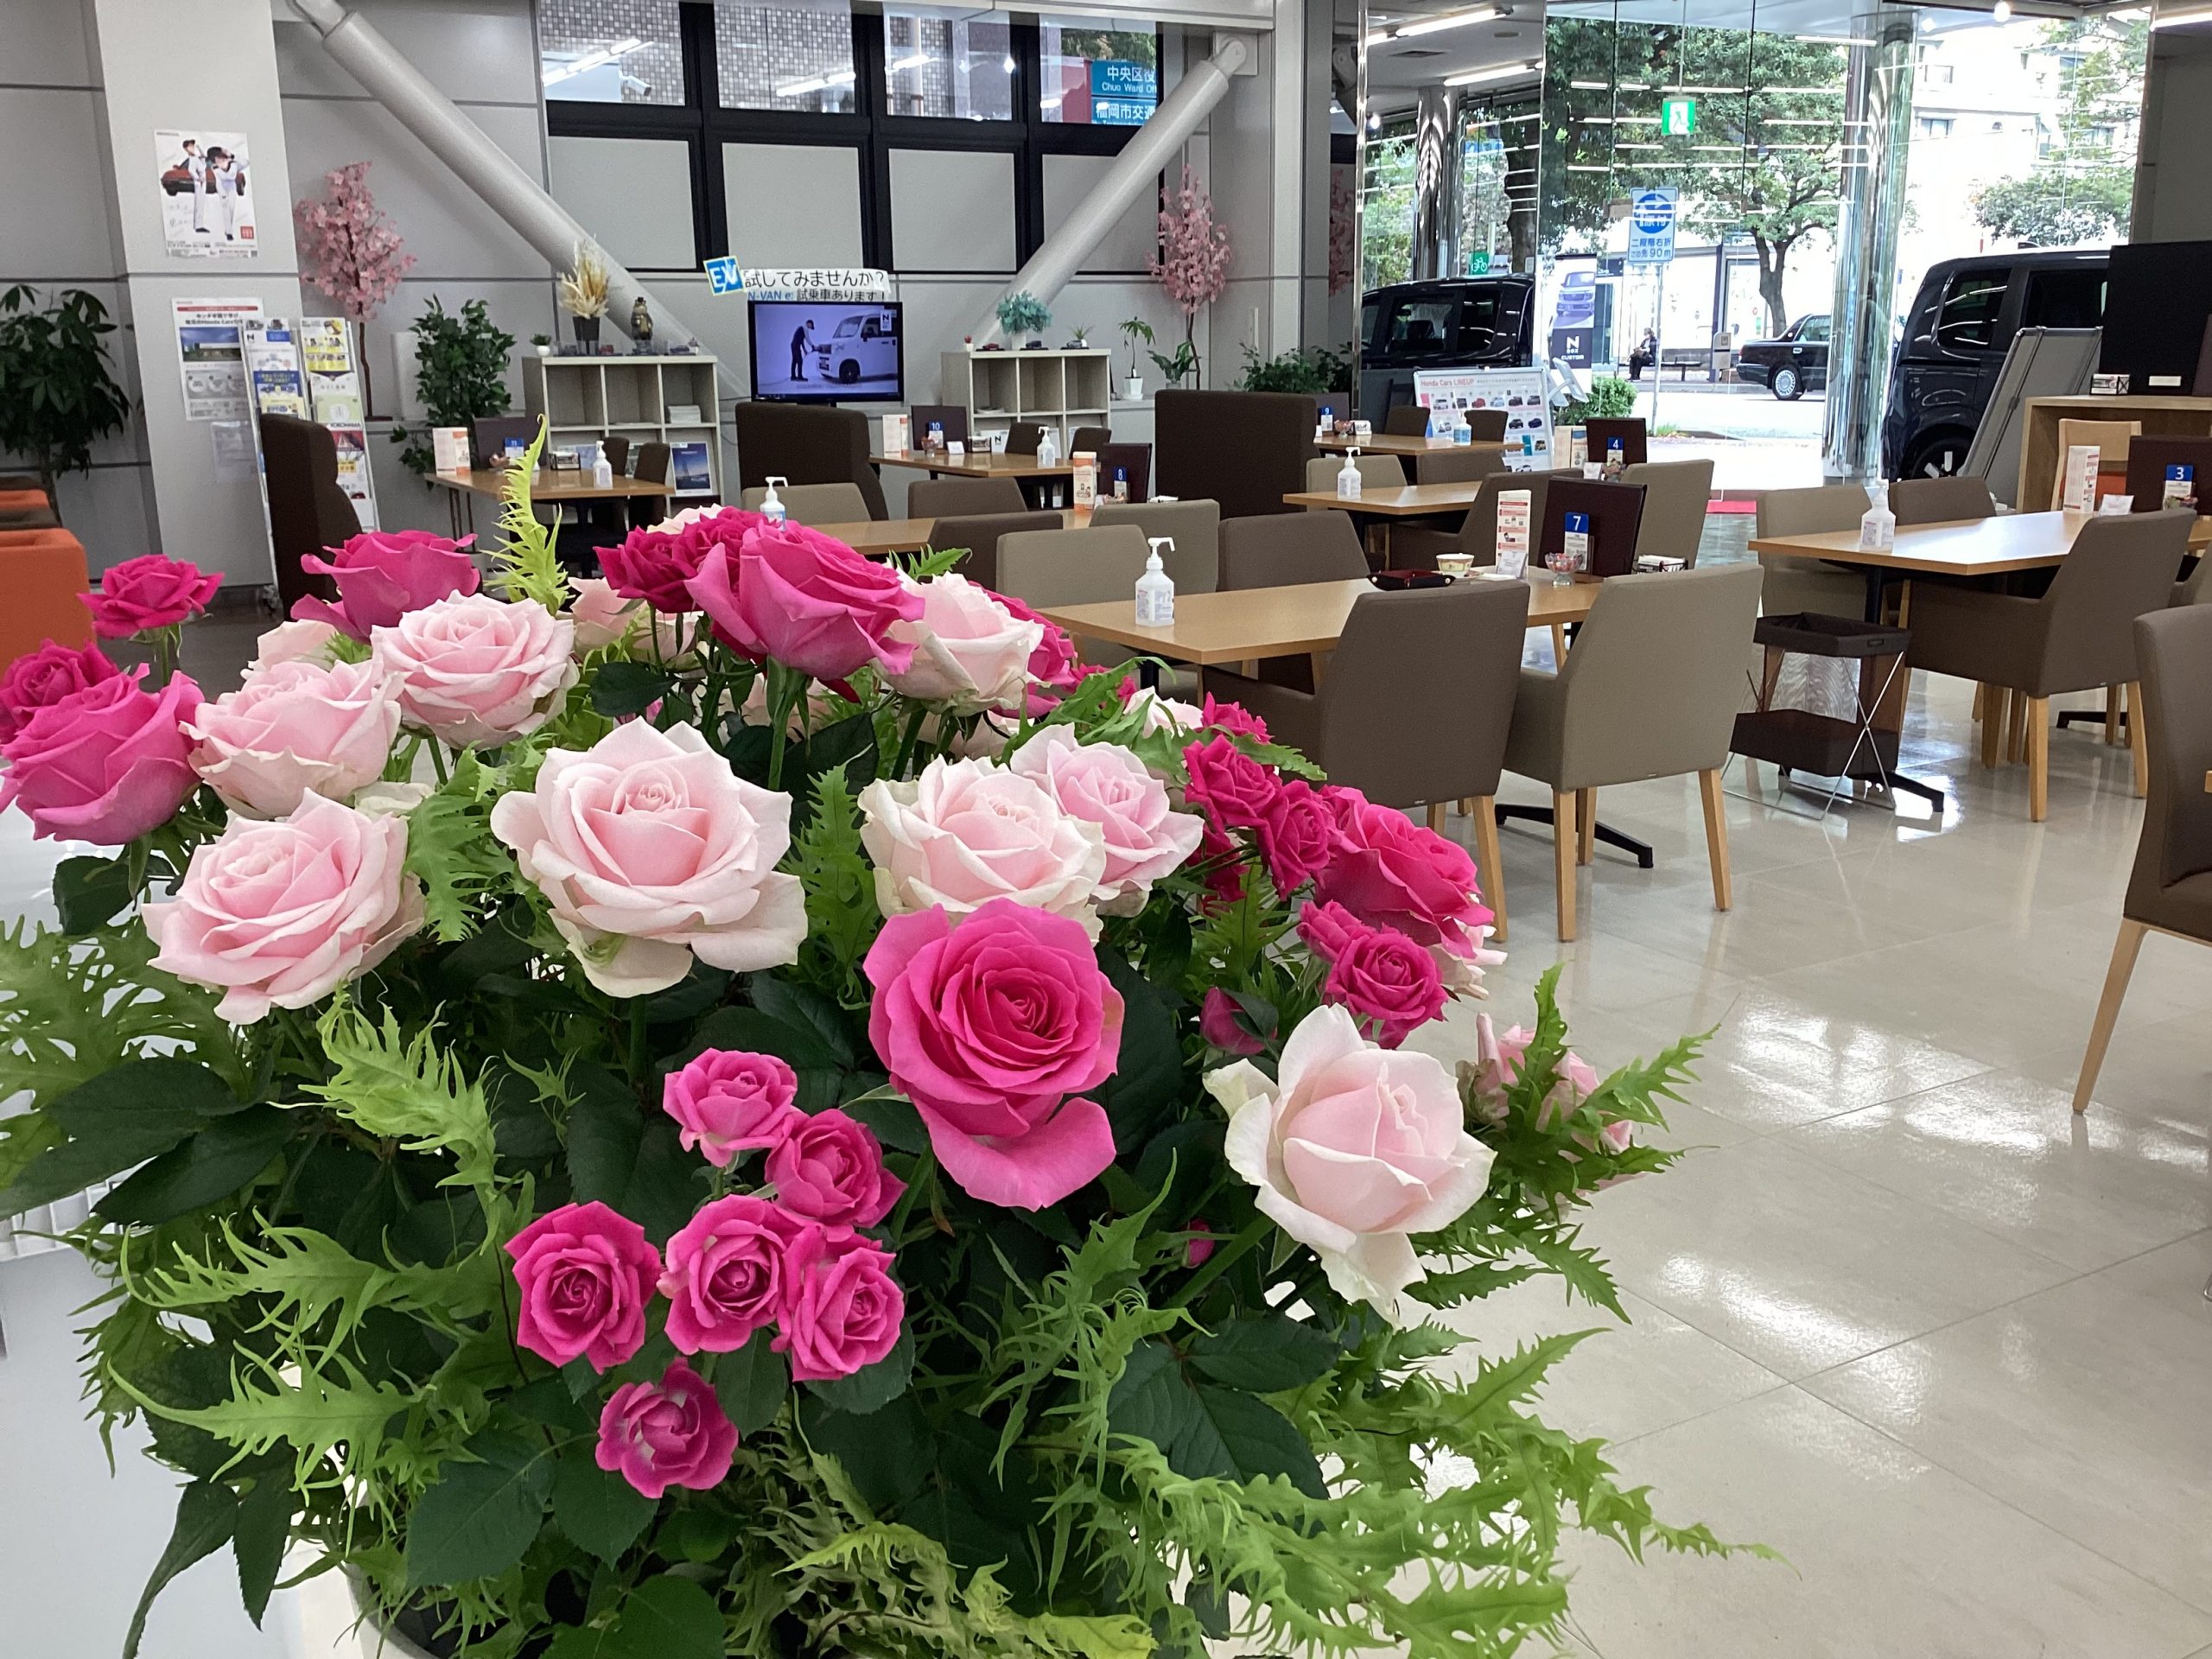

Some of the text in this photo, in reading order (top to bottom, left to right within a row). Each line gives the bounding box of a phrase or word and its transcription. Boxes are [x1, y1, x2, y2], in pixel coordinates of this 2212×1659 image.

[1102, 81, 1122, 92] Chuo
[1124, 83, 1143, 92] Ward
[747, 289, 782, 301] N-VAN
[1566, 335, 1580, 350] N
[931, 423, 940, 431] 10
[1612, 439, 1619, 449] 4
[1117, 468, 1123, 480] 8
[2174, 467, 2185, 480] 3
[1573, 515, 1582, 531] 7
